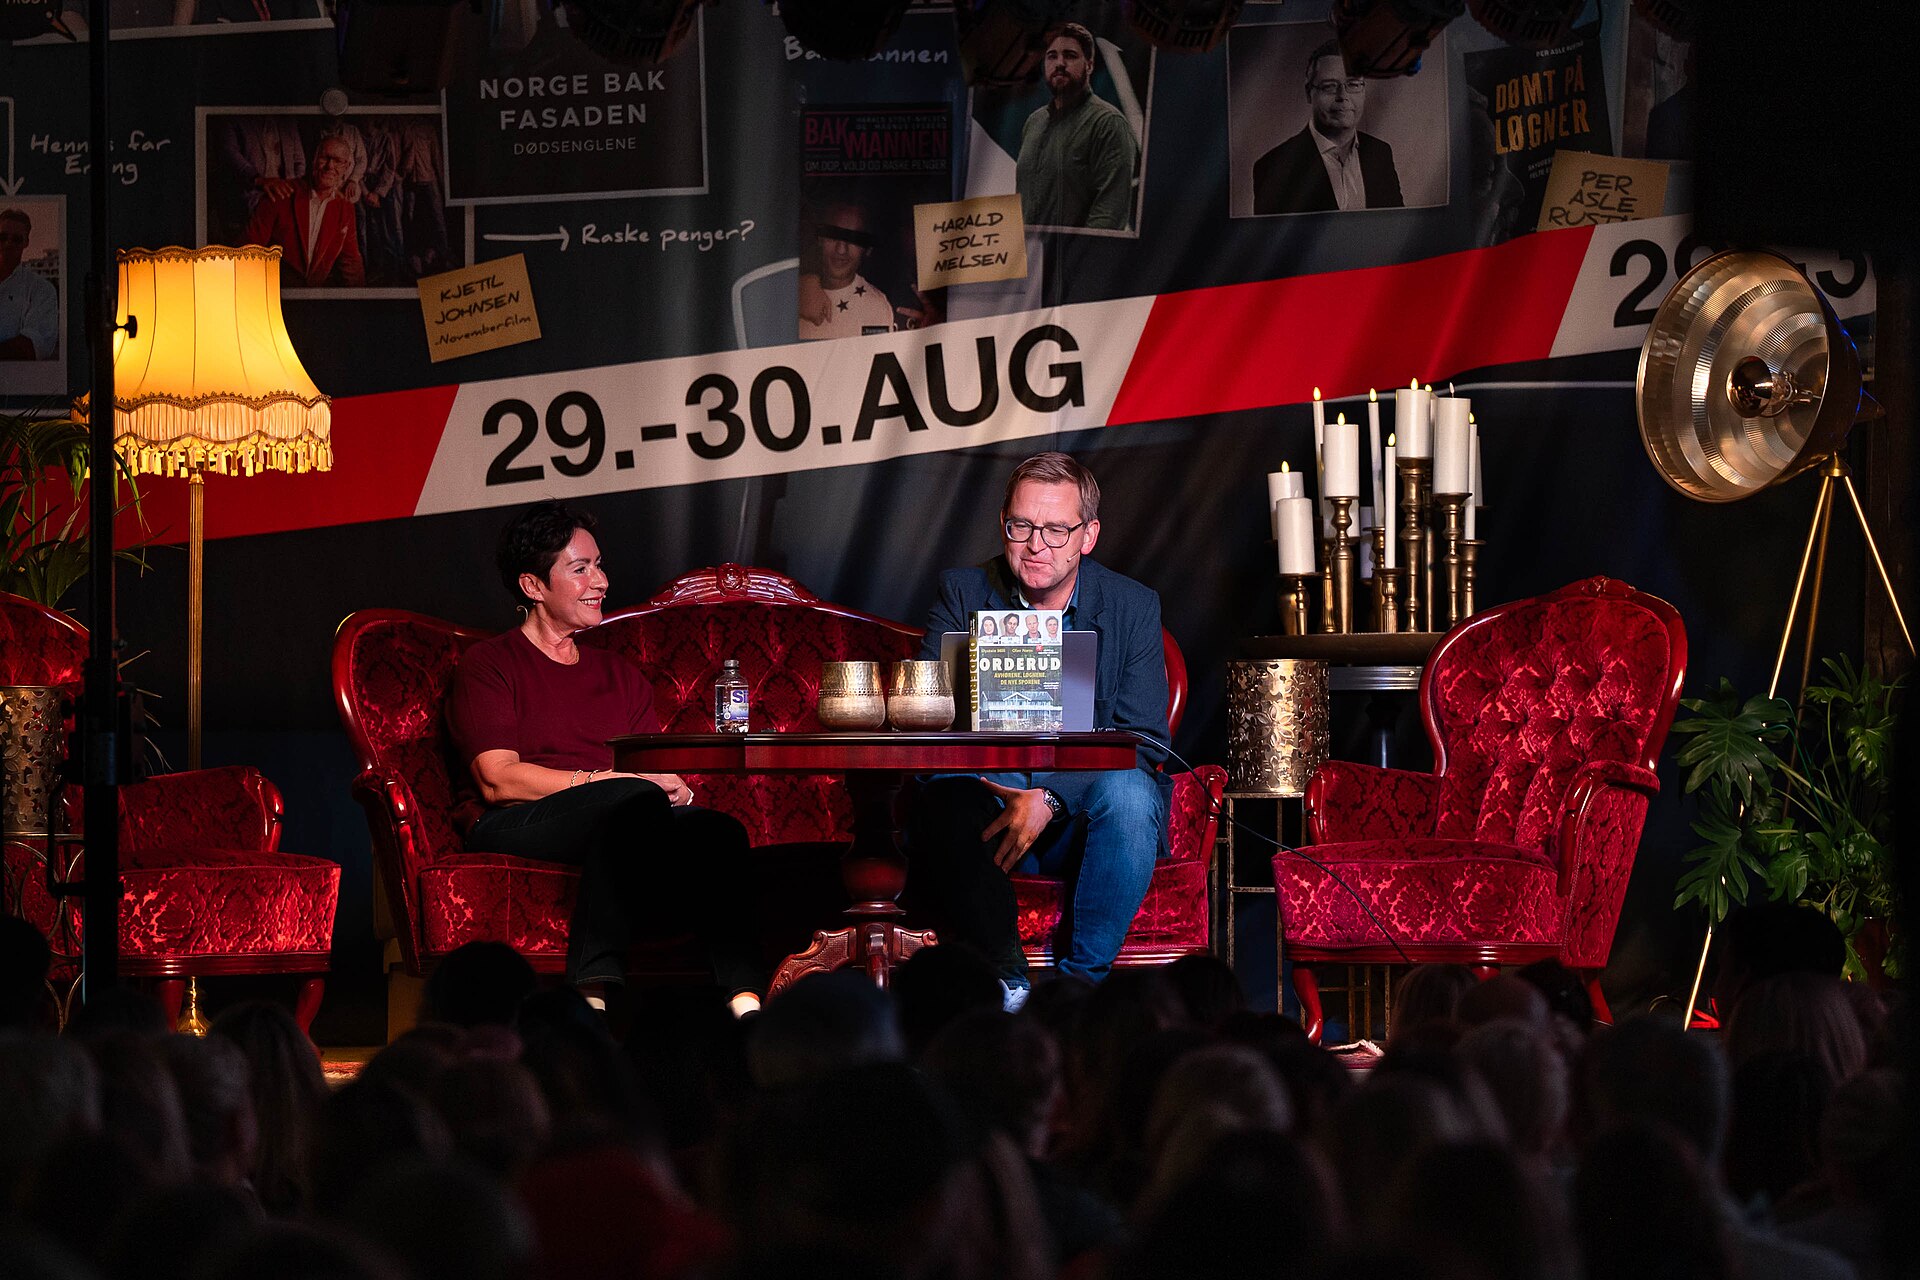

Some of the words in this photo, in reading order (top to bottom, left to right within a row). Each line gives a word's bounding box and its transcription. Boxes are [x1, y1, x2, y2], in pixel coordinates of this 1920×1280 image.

[783, 35, 949, 63] Baannen
[479, 73, 589, 100] NORGE
[603, 70, 666, 94] BAK
[1494, 69, 1557, 114] DØMT
[1564, 54, 1585, 96] PÅ
[499, 103, 648, 132] FASADEN
[804, 116, 850, 146] BAK
[1493, 98, 1592, 156] LØGNER
[31, 132, 115, 154] Henn
[127, 129, 172, 152] far
[513, 136, 637, 156] DØDSENGLENE
[846, 128, 949, 159] MANNEN
[64, 152, 140, 186] Erng
[1580, 170, 1634, 195] PER
[1568, 189, 1638, 213] ASLE
[932, 212, 1004, 233] HARALD
[1548, 206, 1644, 226] RUST
[581, 222, 650, 245] Raske
[659, 219, 755, 252] penger?
[440, 274, 505, 303] KJETIL
[434, 290, 520, 325] JOHNSEN
[979, 657, 1061, 672] ORDERUD
